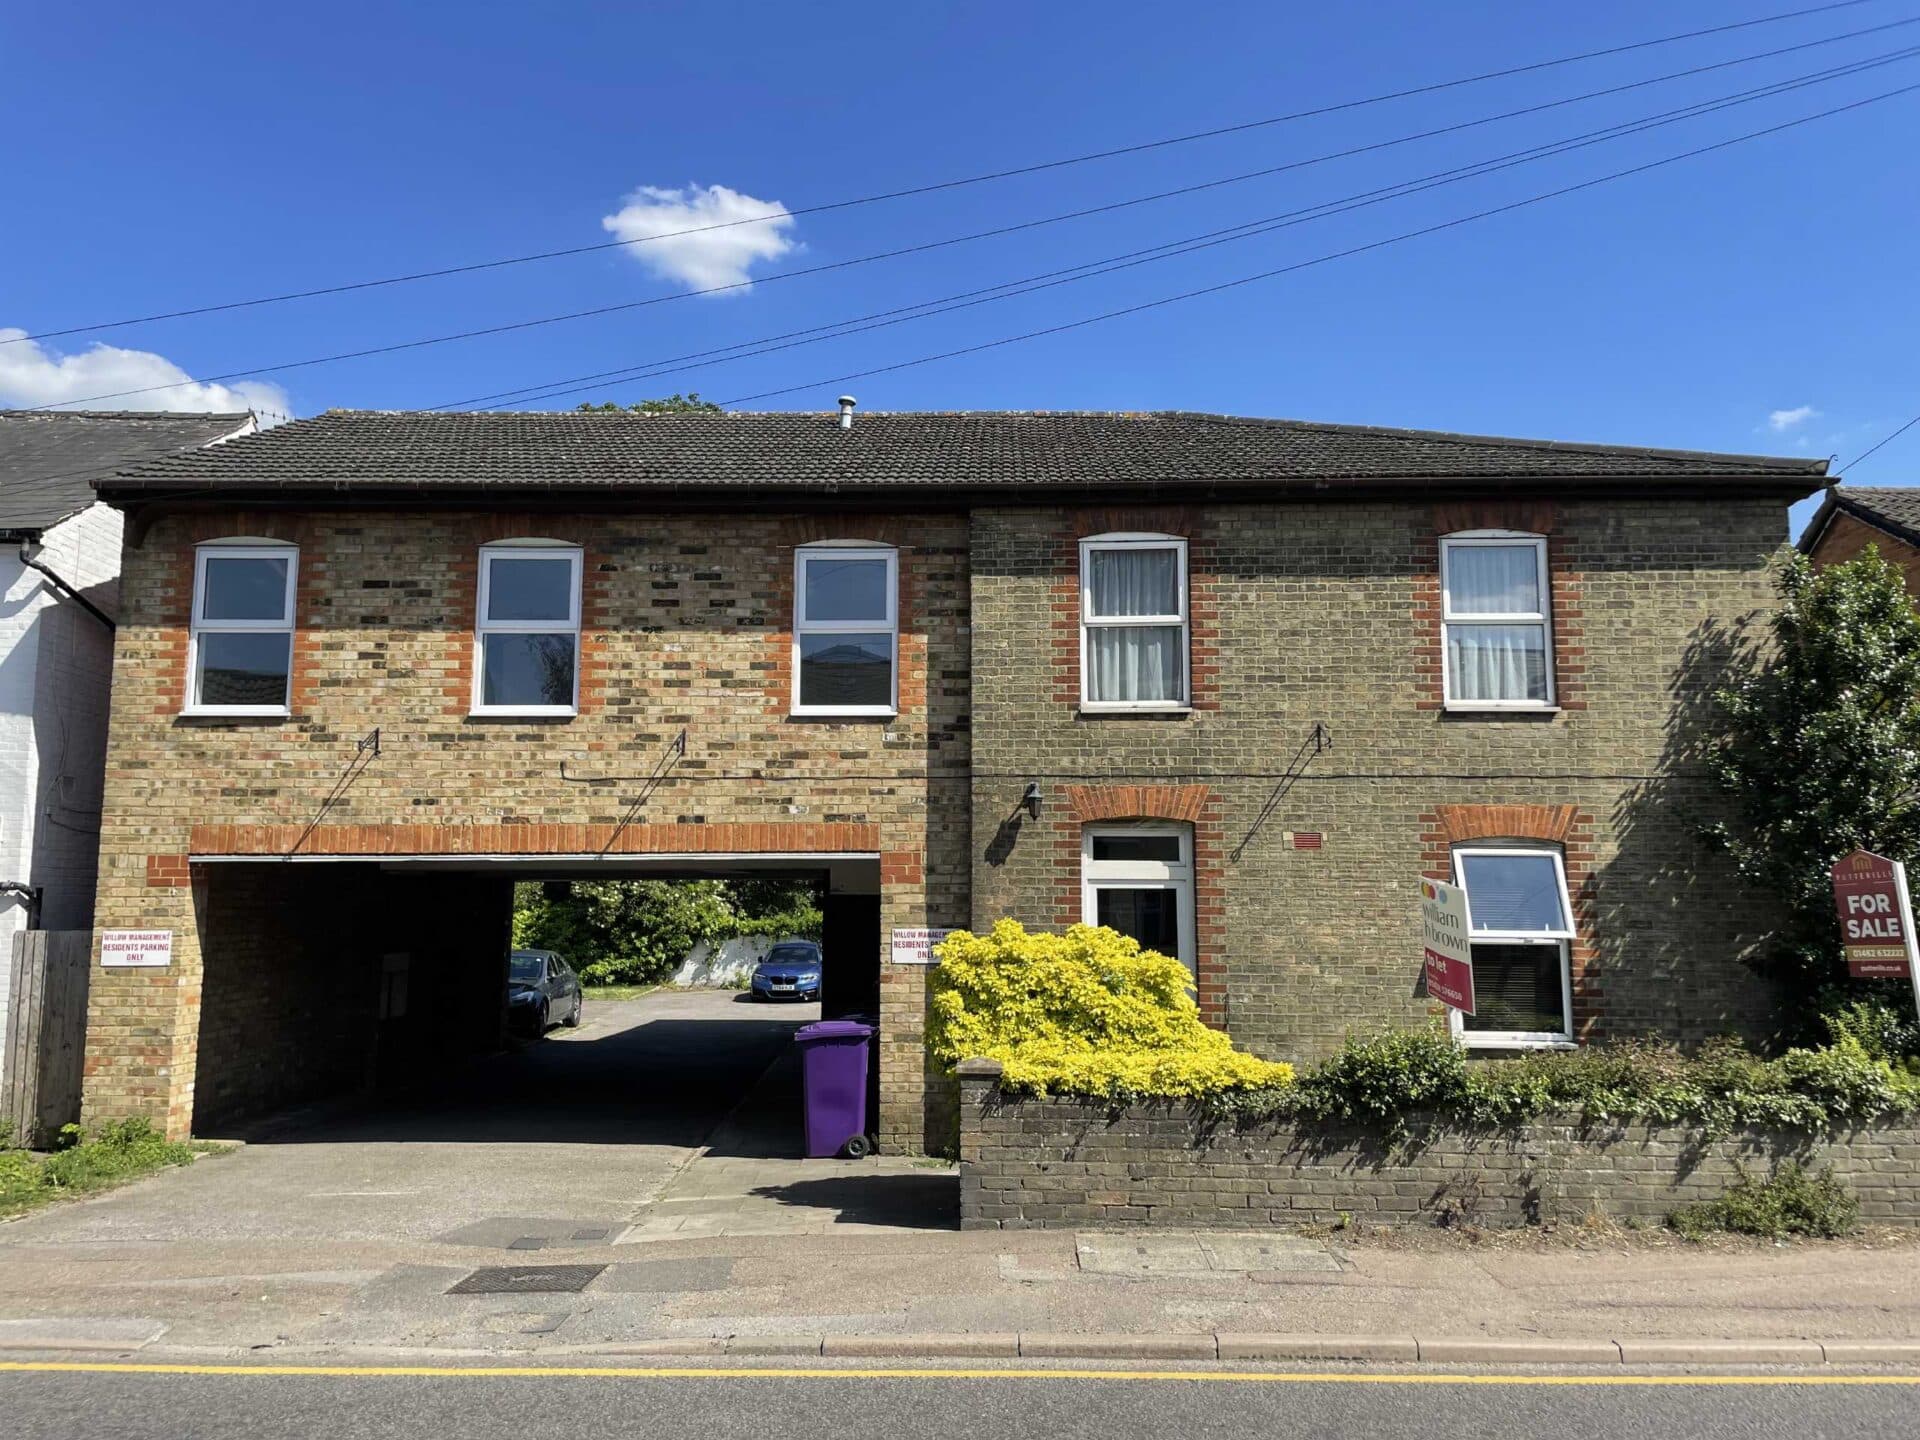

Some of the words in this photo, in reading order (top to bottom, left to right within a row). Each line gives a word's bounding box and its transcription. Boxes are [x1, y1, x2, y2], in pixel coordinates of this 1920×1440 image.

[1847, 893, 1891, 914] FOR
[1847, 917, 1901, 938] SALE
[103, 933, 127, 941] WILLOW
[128, 932, 170, 941] MANAGEMENT
[893, 930, 917, 939] WILLOW
[1432, 922, 1468, 953] brown
[103, 943, 139, 951] RESIDENTS
[140, 943, 169, 951] PARKING
[893, 940, 929, 949] RESIDENTS
[126, 953, 145, 961] ONLY
[1426, 952, 1435, 967] to
[1435, 954, 1447, 974] let
